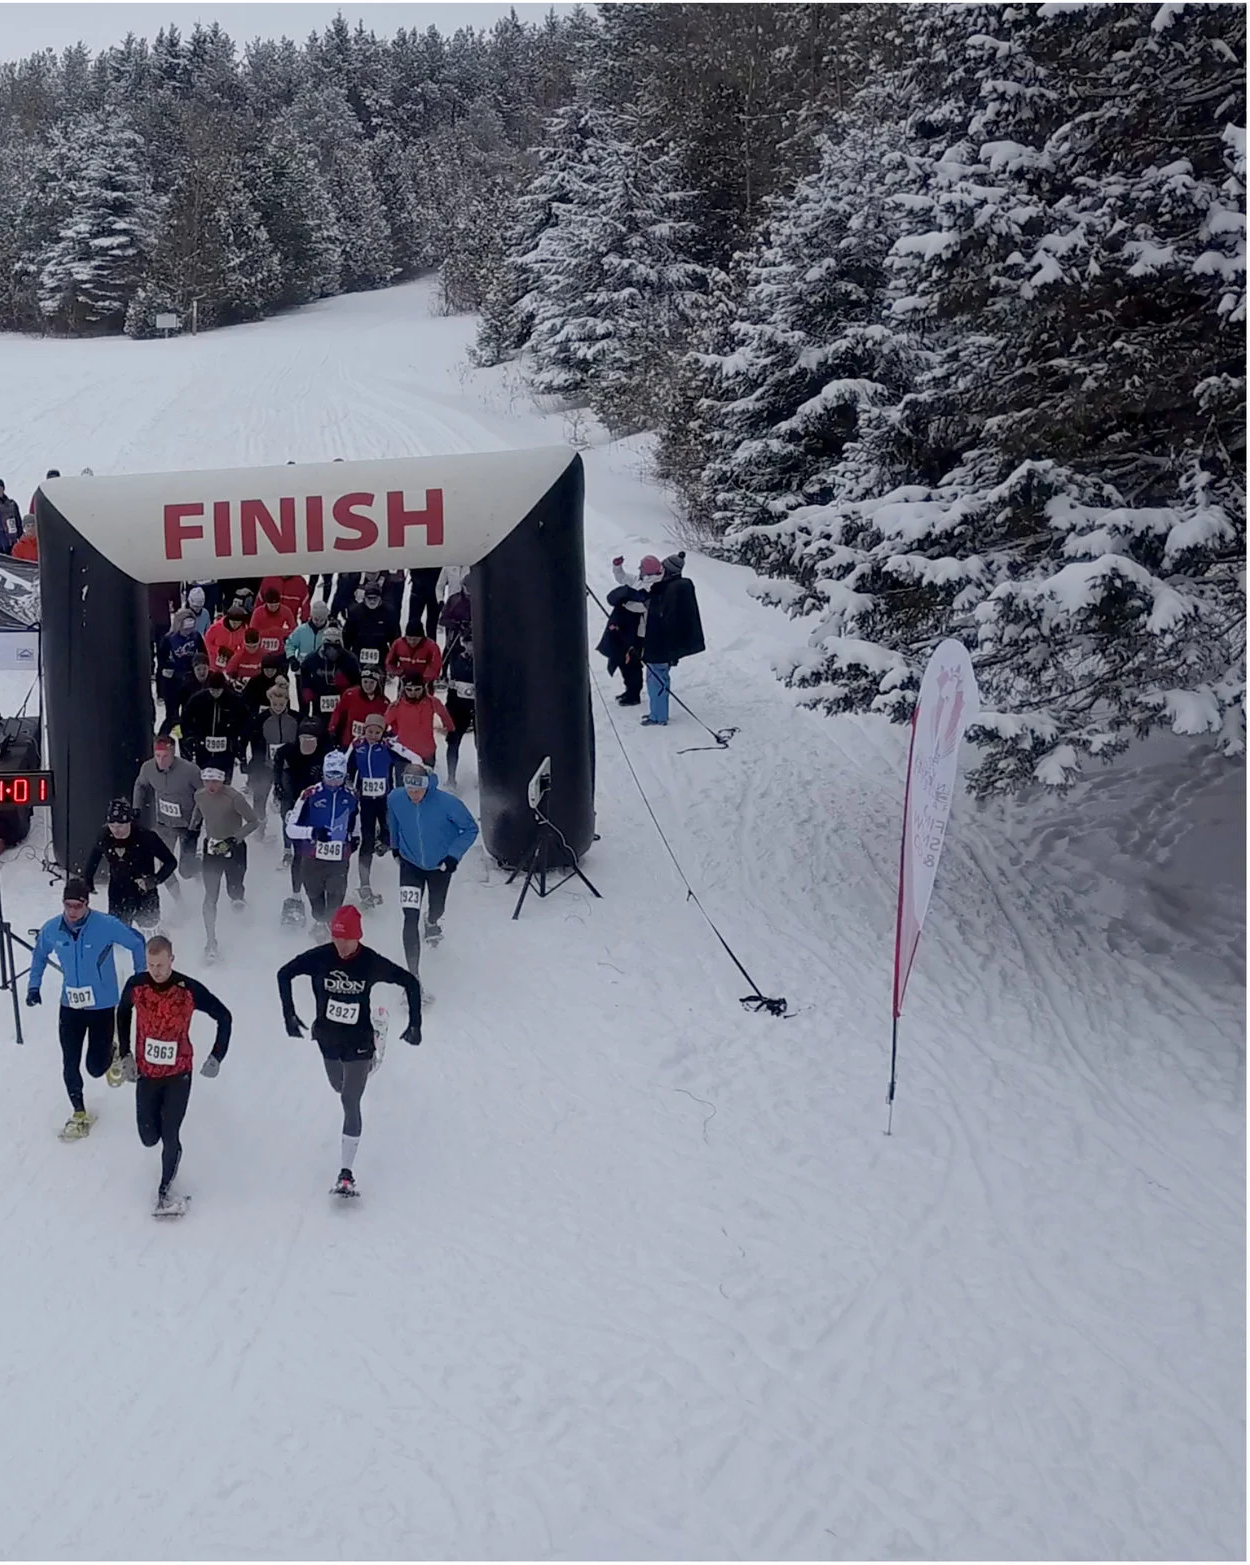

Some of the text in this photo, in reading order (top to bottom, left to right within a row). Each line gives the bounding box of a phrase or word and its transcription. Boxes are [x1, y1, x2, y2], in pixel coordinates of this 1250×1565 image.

[164, 488, 444, 560] FINISH
[317, 842, 341, 856] 2946
[323, 978, 366, 990] DION
[328, 1004, 357, 1019] 2927
[146, 1043, 175, 1059] 2963
